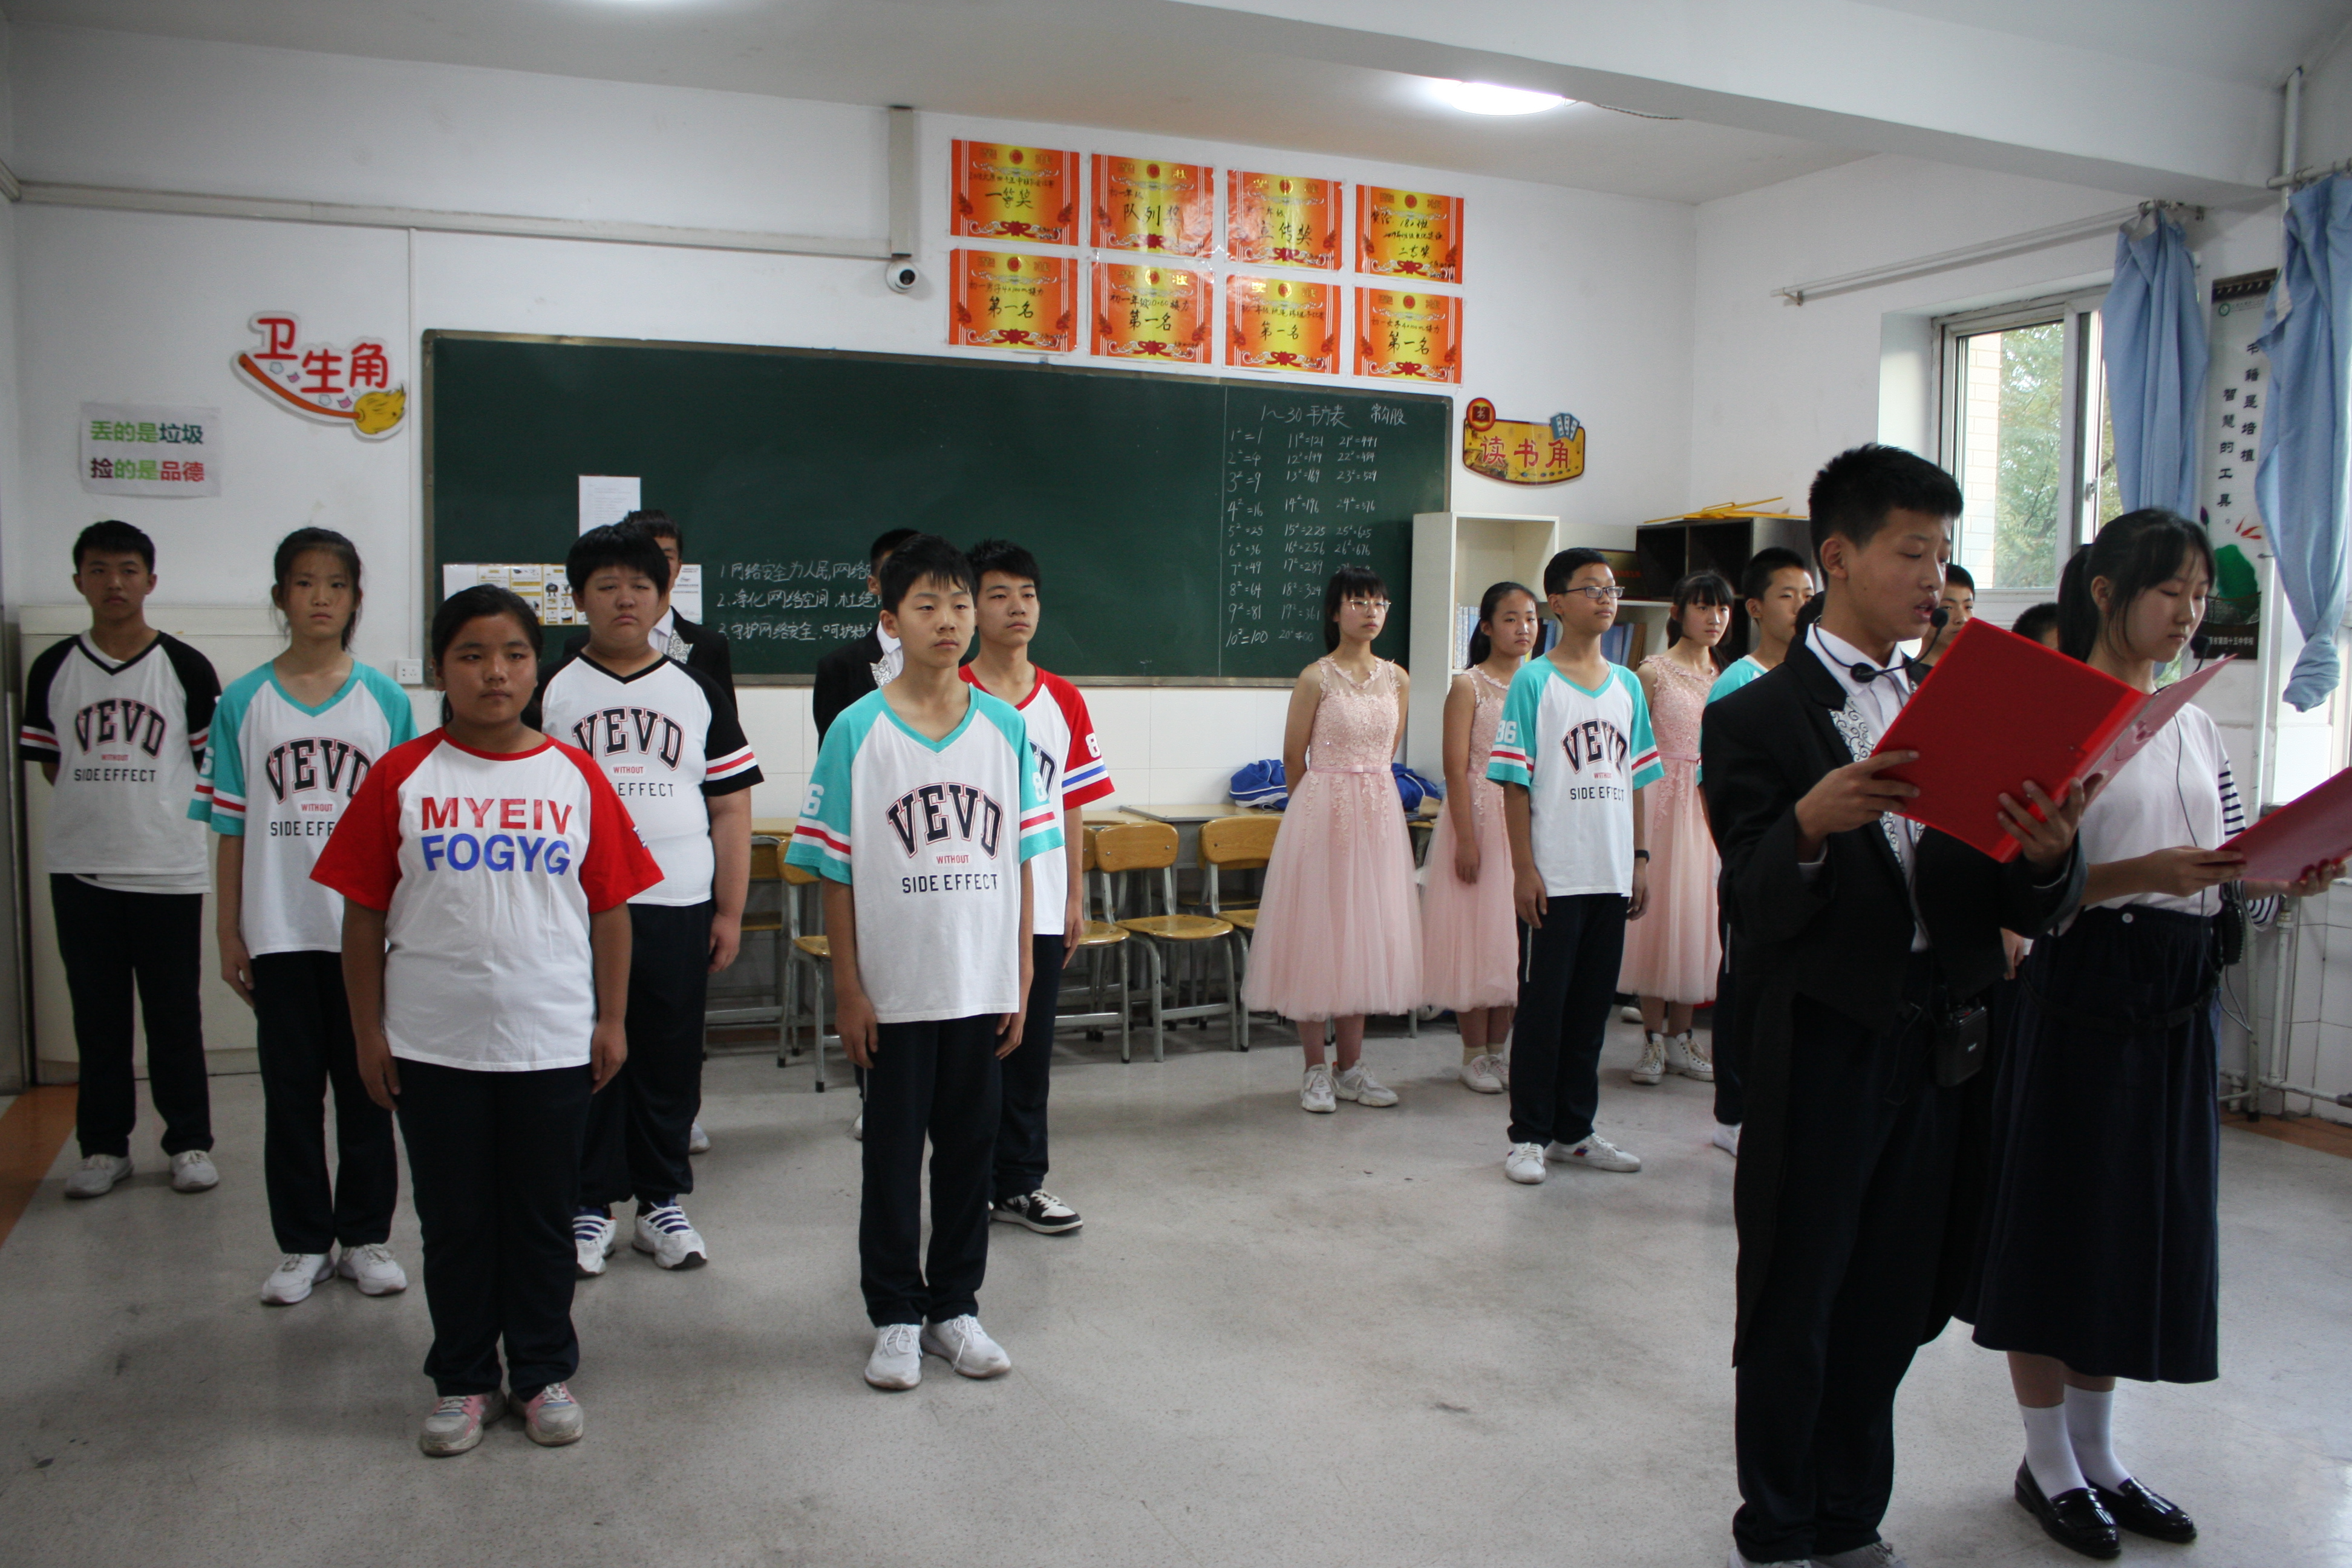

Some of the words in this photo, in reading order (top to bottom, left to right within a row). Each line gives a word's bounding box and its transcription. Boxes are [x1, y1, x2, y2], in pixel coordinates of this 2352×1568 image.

[985, 188, 1033, 209] 一等奖
[1124, 203, 1181, 226] 队列奖
[1257, 219, 1313, 246] 宣传奖
[1398, 244, 1429, 258] 二等奖
[987, 295, 1034, 318] 第一名
[1129, 309, 1172, 331] 第一名
[1259, 320, 1299, 341] 第一名
[1386, 330, 1430, 354] 第一名
[253, 318, 388, 394] 卫生角
[2240, 342, 2260, 463] 书籍是培植
[90, 420, 204, 445] 丢的是垃圾
[1480, 435, 1569, 470] 读书角
[90, 457, 205, 482] 捡的是品德
[1495, 719, 1517, 744] 86
[74, 768, 101, 782] SIDE
[103, 768, 157, 782] EFFECT
[618, 783, 674, 797] EFFECT
[1570, 786, 1596, 800] SIDE
[301, 803, 333, 812] WITHOUT
[422, 797, 573, 835] MYEIV
[270, 821, 301, 837] SIDE
[421, 833, 571, 876] FOGYG
[936, 854, 970, 864] WITHOUT
[901, 875, 939, 893] SIDE
[943, 874, 998, 890] EFFECT
